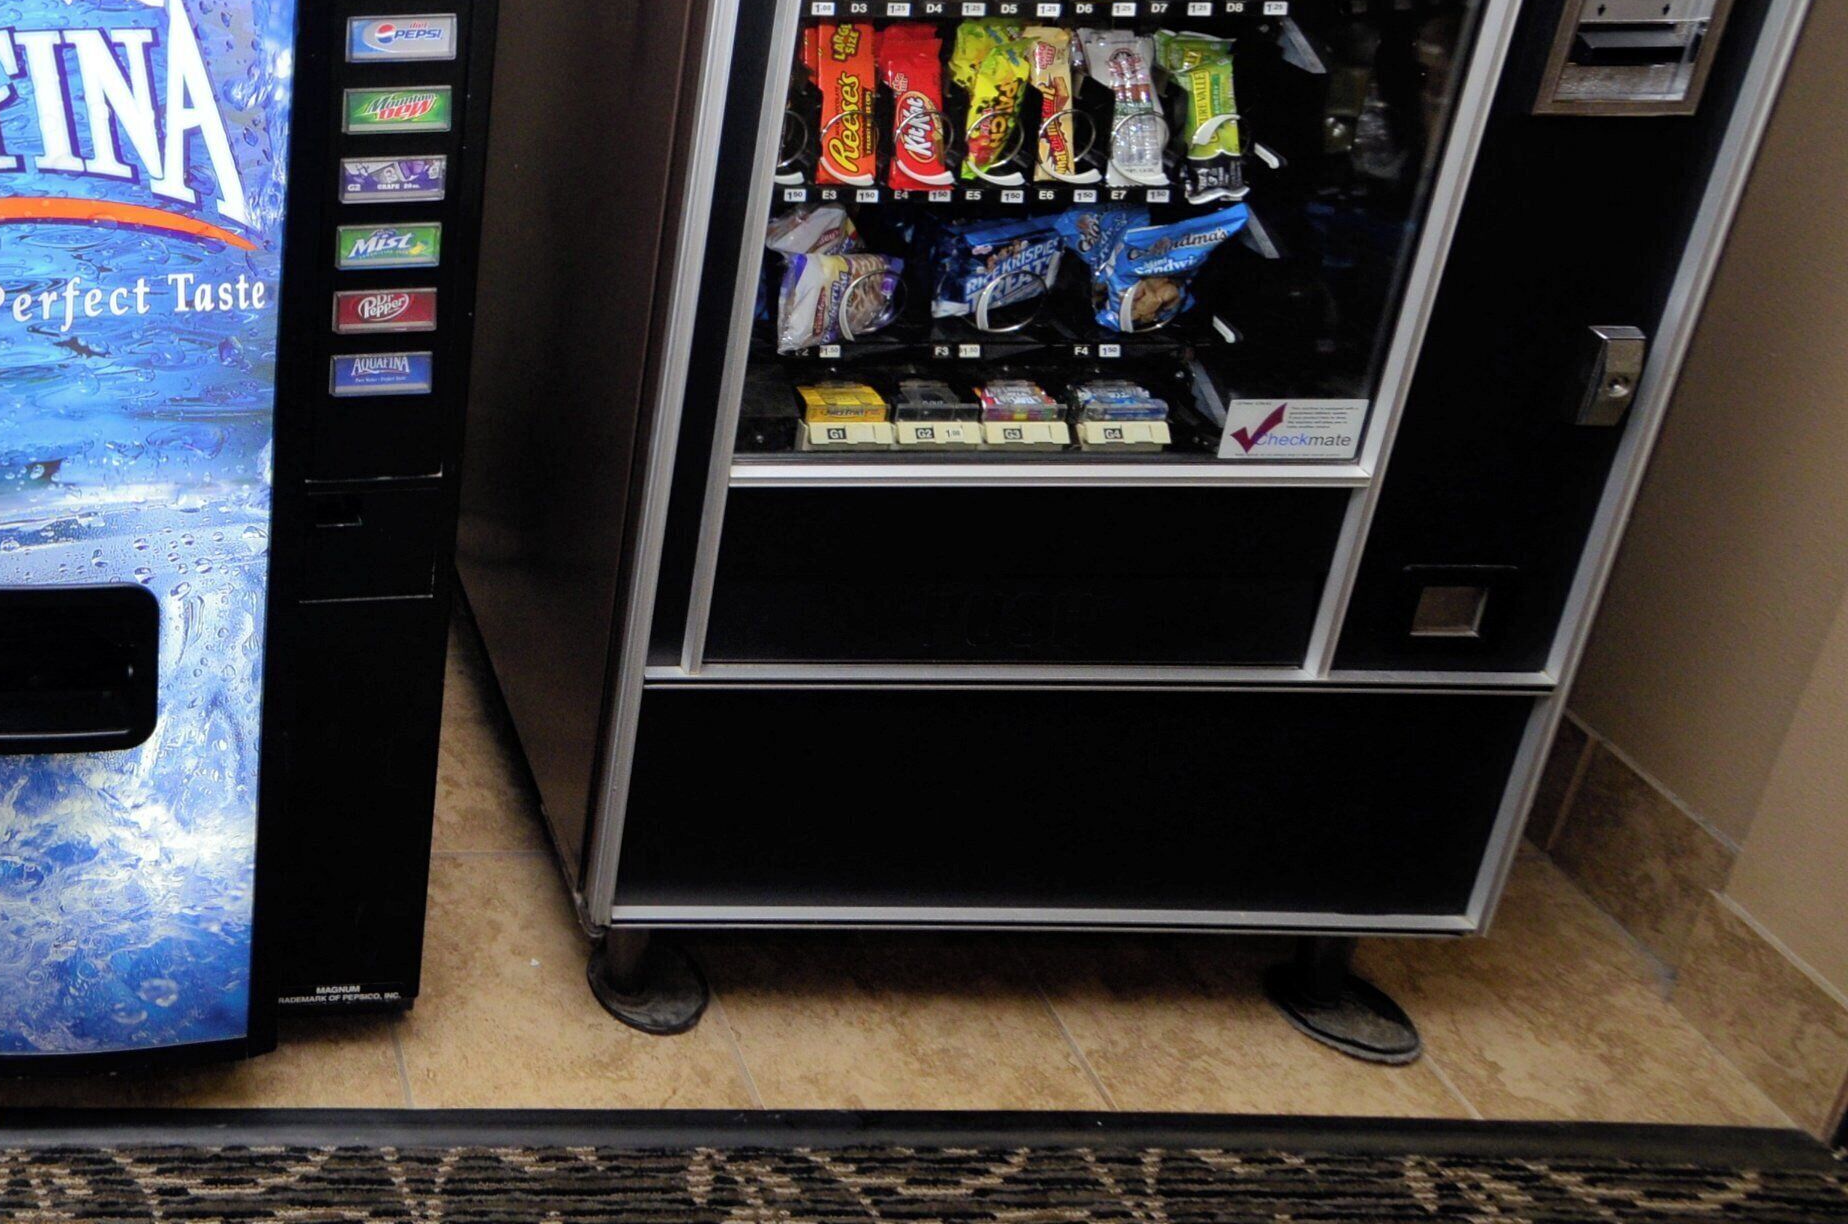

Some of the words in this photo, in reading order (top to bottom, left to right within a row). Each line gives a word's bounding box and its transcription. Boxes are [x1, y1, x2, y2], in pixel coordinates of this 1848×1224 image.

[851, 3, 867, 13] D3
[927, 3, 942, 13] D4
[1001, 4, 1017, 14] D5
[1076, 4, 1093, 13] D6
[1152, 3, 1168, 13] D7
[1226, 3, 1243, 12] D8
[395, 28, 443, 40] PEPSI
[365, 93, 434, 113] Mountain
[828, 72, 860, 173] Reese's
[822, 191, 837, 199] E3
[894, 190, 908, 199] E4
[966, 191, 981, 199] E5
[1039, 191, 1054, 199] E6
[1112, 191, 1126, 199] E7
[349, 233, 412, 258] Mist
[1128, 229, 1228, 260] Gndma's
[1134, 256, 1198, 275] Sandwi
[167, 272, 267, 315] Taste
[376, 294, 394, 306] Dr
[363, 297, 406, 318] Pepper
[935, 347, 949, 356] F3
[1074, 346, 1088, 356] F4
[351, 357, 410, 376] AQUAFINA
[829, 430, 844, 438] G1
[917, 429, 932, 438] G2
[1106, 430, 1122, 438] G4
[1254, 432, 1352, 447] Checkmate
[316, 985, 361, 994] MAGNUM
[278, 996, 326, 1004] RADEMARK
[342, 993, 382, 1001] PEPSICO,
[384, 992, 402, 1000] INC.
